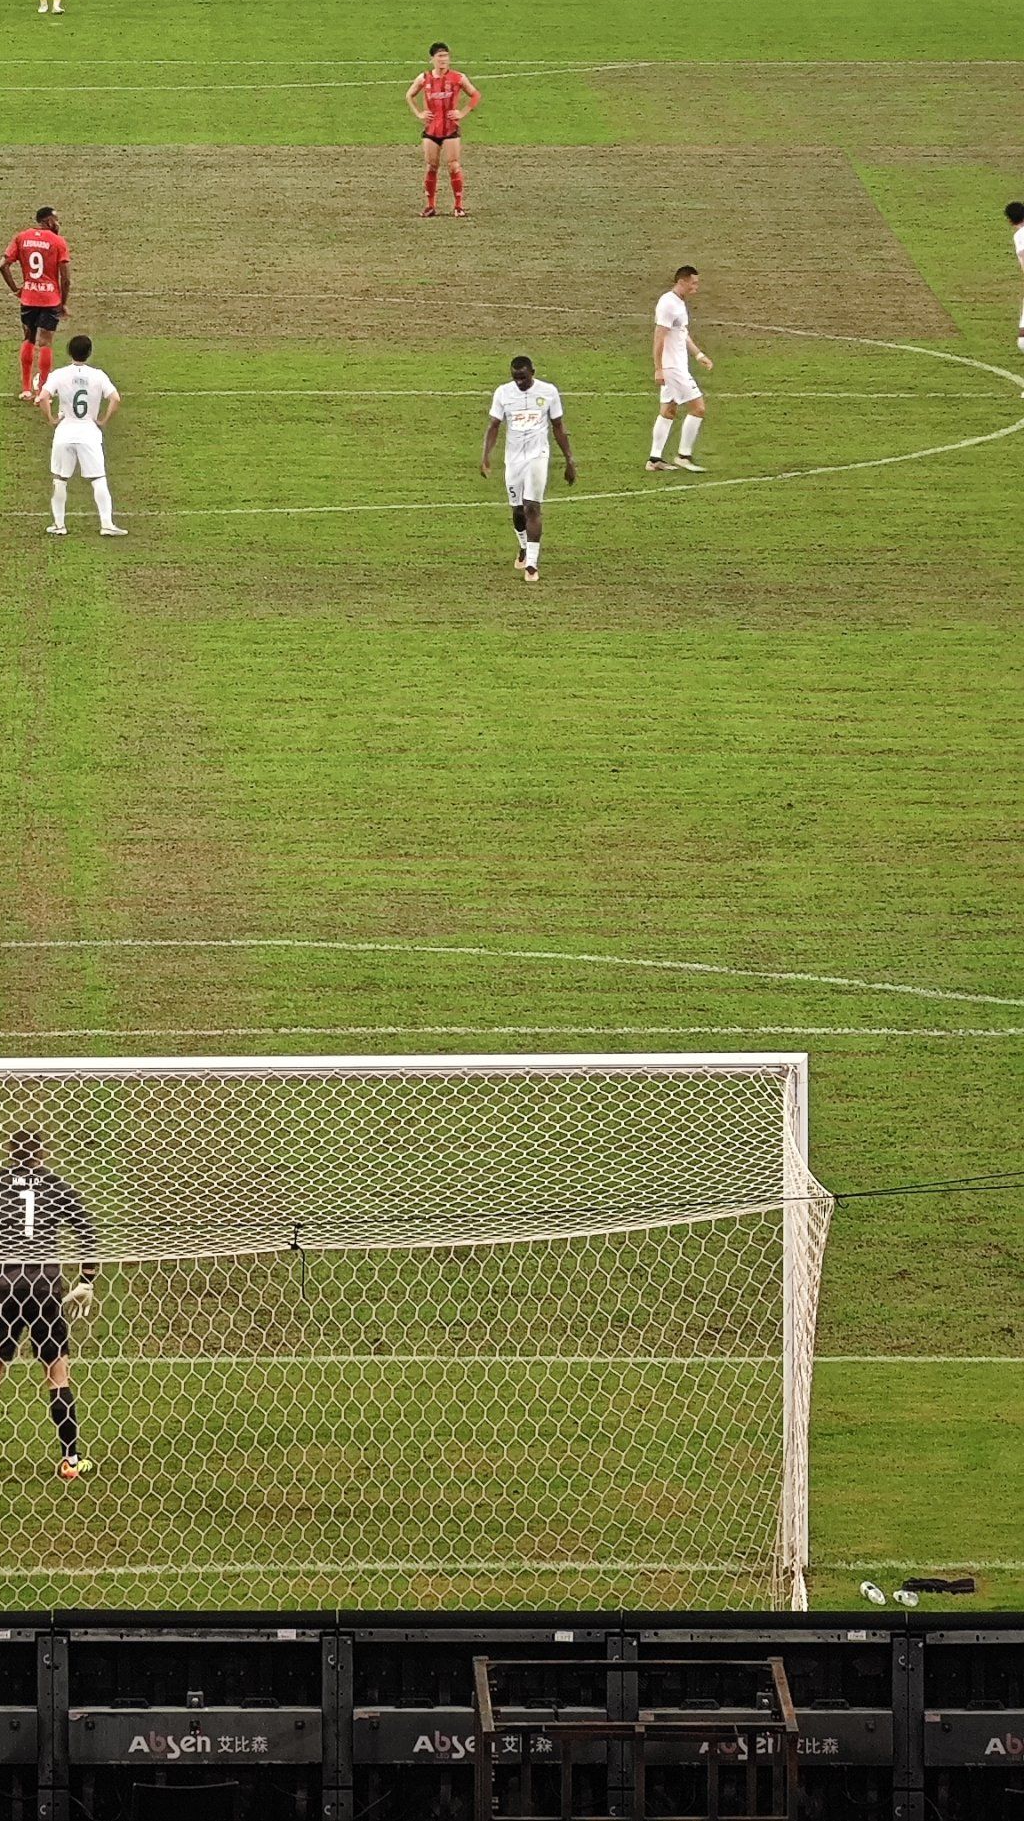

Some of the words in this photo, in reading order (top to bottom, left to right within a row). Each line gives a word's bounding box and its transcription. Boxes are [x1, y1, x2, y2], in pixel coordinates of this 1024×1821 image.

[29, 251, 44, 280] 9
[72, 389, 88, 419] 6
[19, 1190, 35, 1237] 1
[217, 1735, 269, 1754] 艾比森
